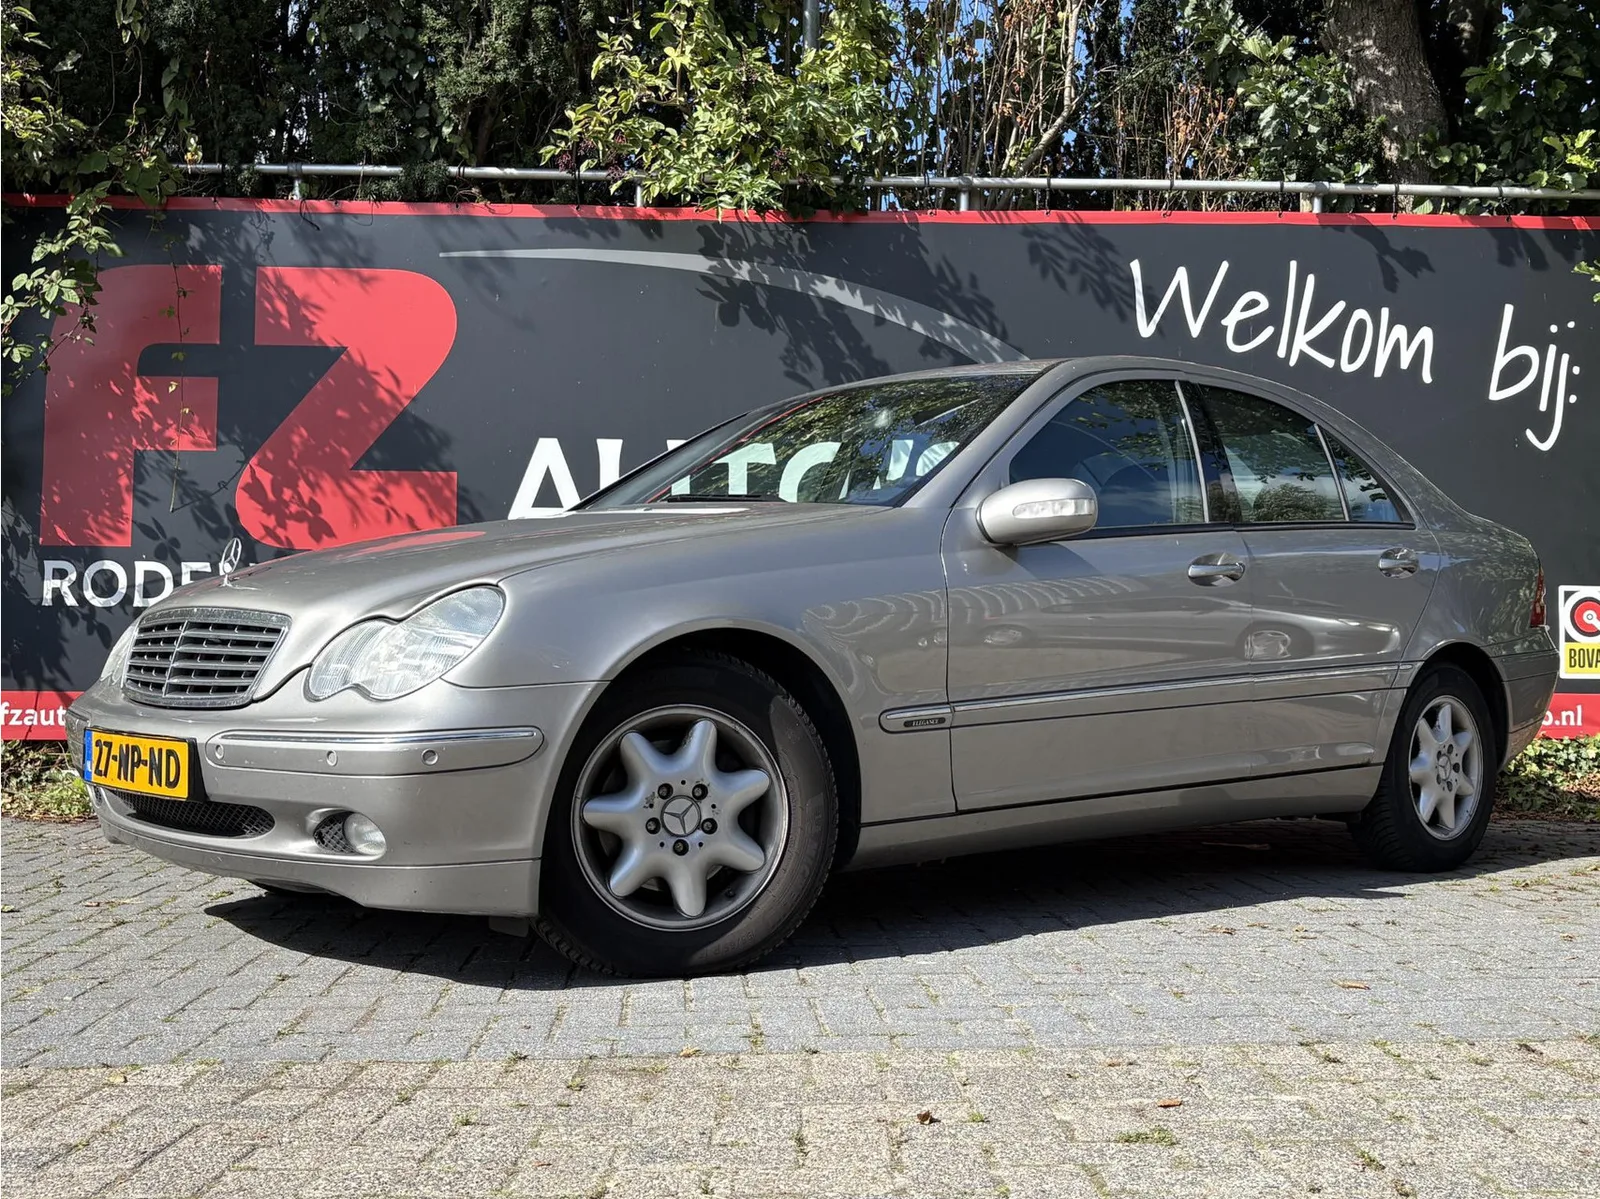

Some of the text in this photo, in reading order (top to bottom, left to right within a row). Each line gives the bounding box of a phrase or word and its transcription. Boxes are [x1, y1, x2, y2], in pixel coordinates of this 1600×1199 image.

[1130, 259, 1580, 452] Welkom bij:
[94, 738, 181, 790] 27-NP-ND
